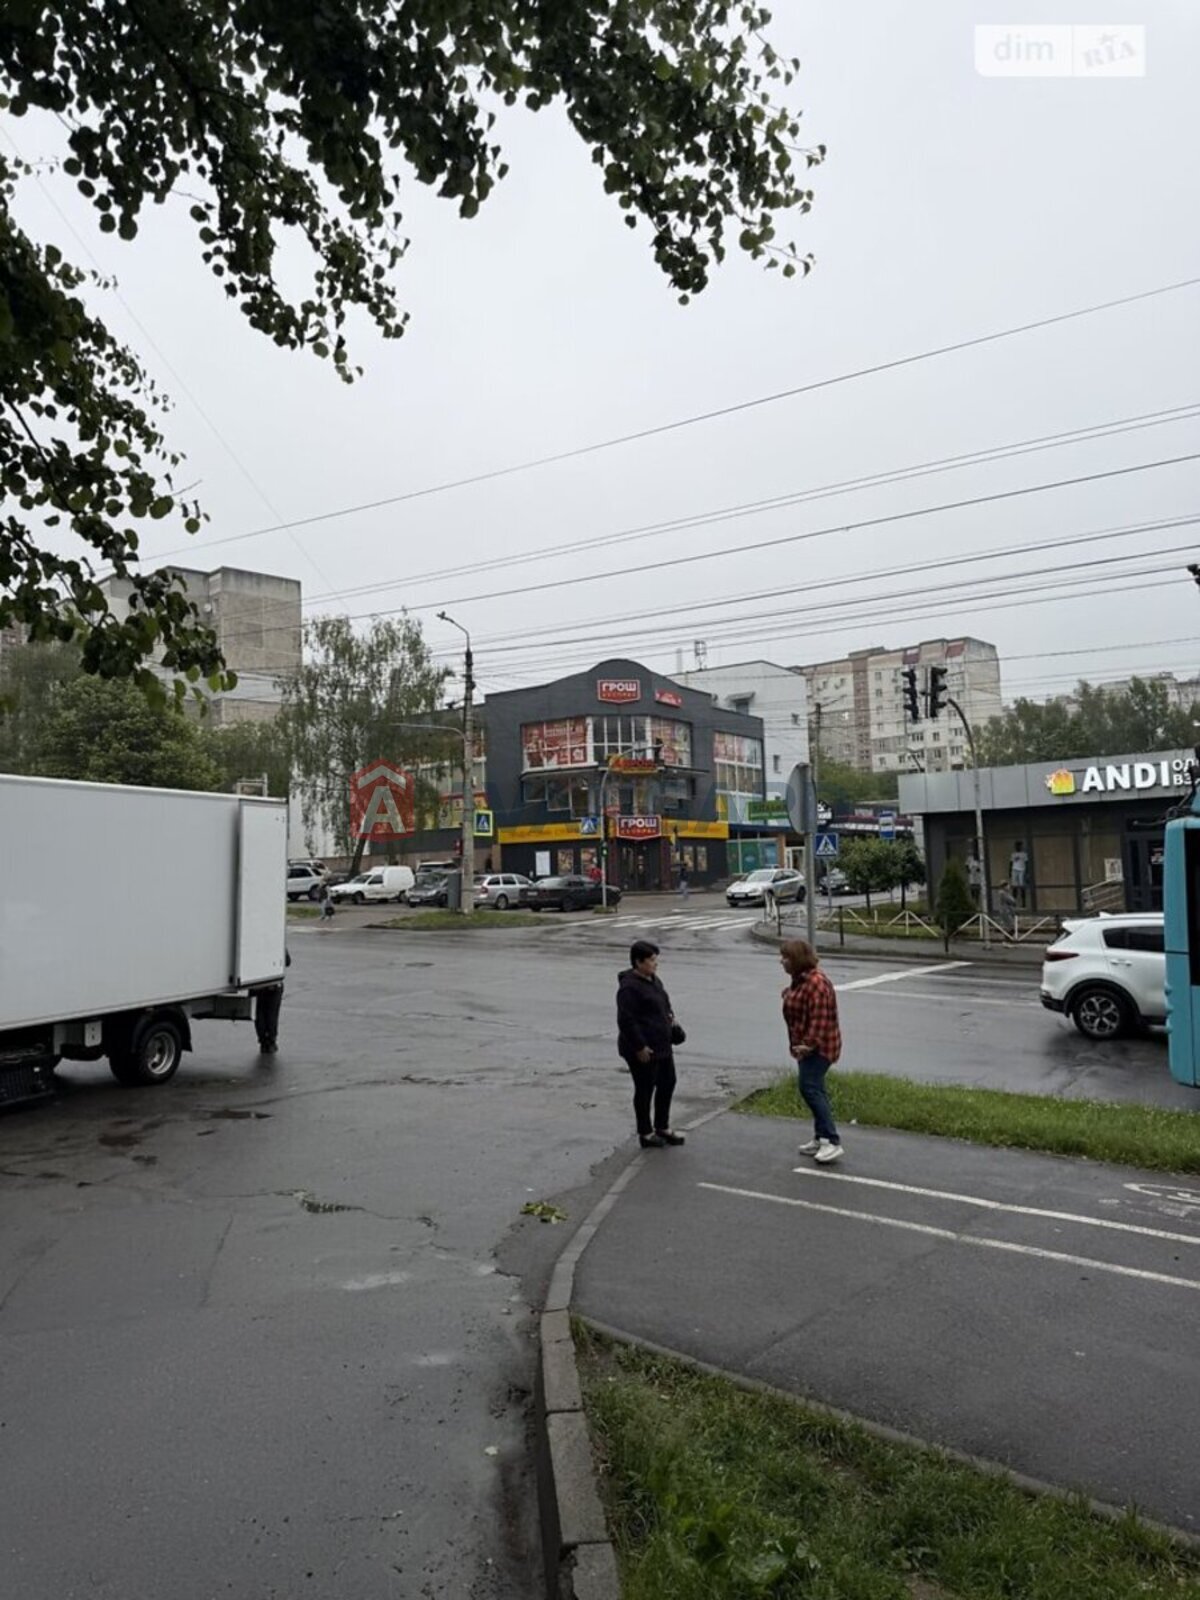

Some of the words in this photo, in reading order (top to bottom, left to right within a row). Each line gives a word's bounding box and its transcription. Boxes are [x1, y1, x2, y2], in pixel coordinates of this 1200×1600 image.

[602, 682, 637, 692] ГРОШ
[1081, 760, 1170, 792] ANDI
[620, 818, 657, 828] ГРОШ
